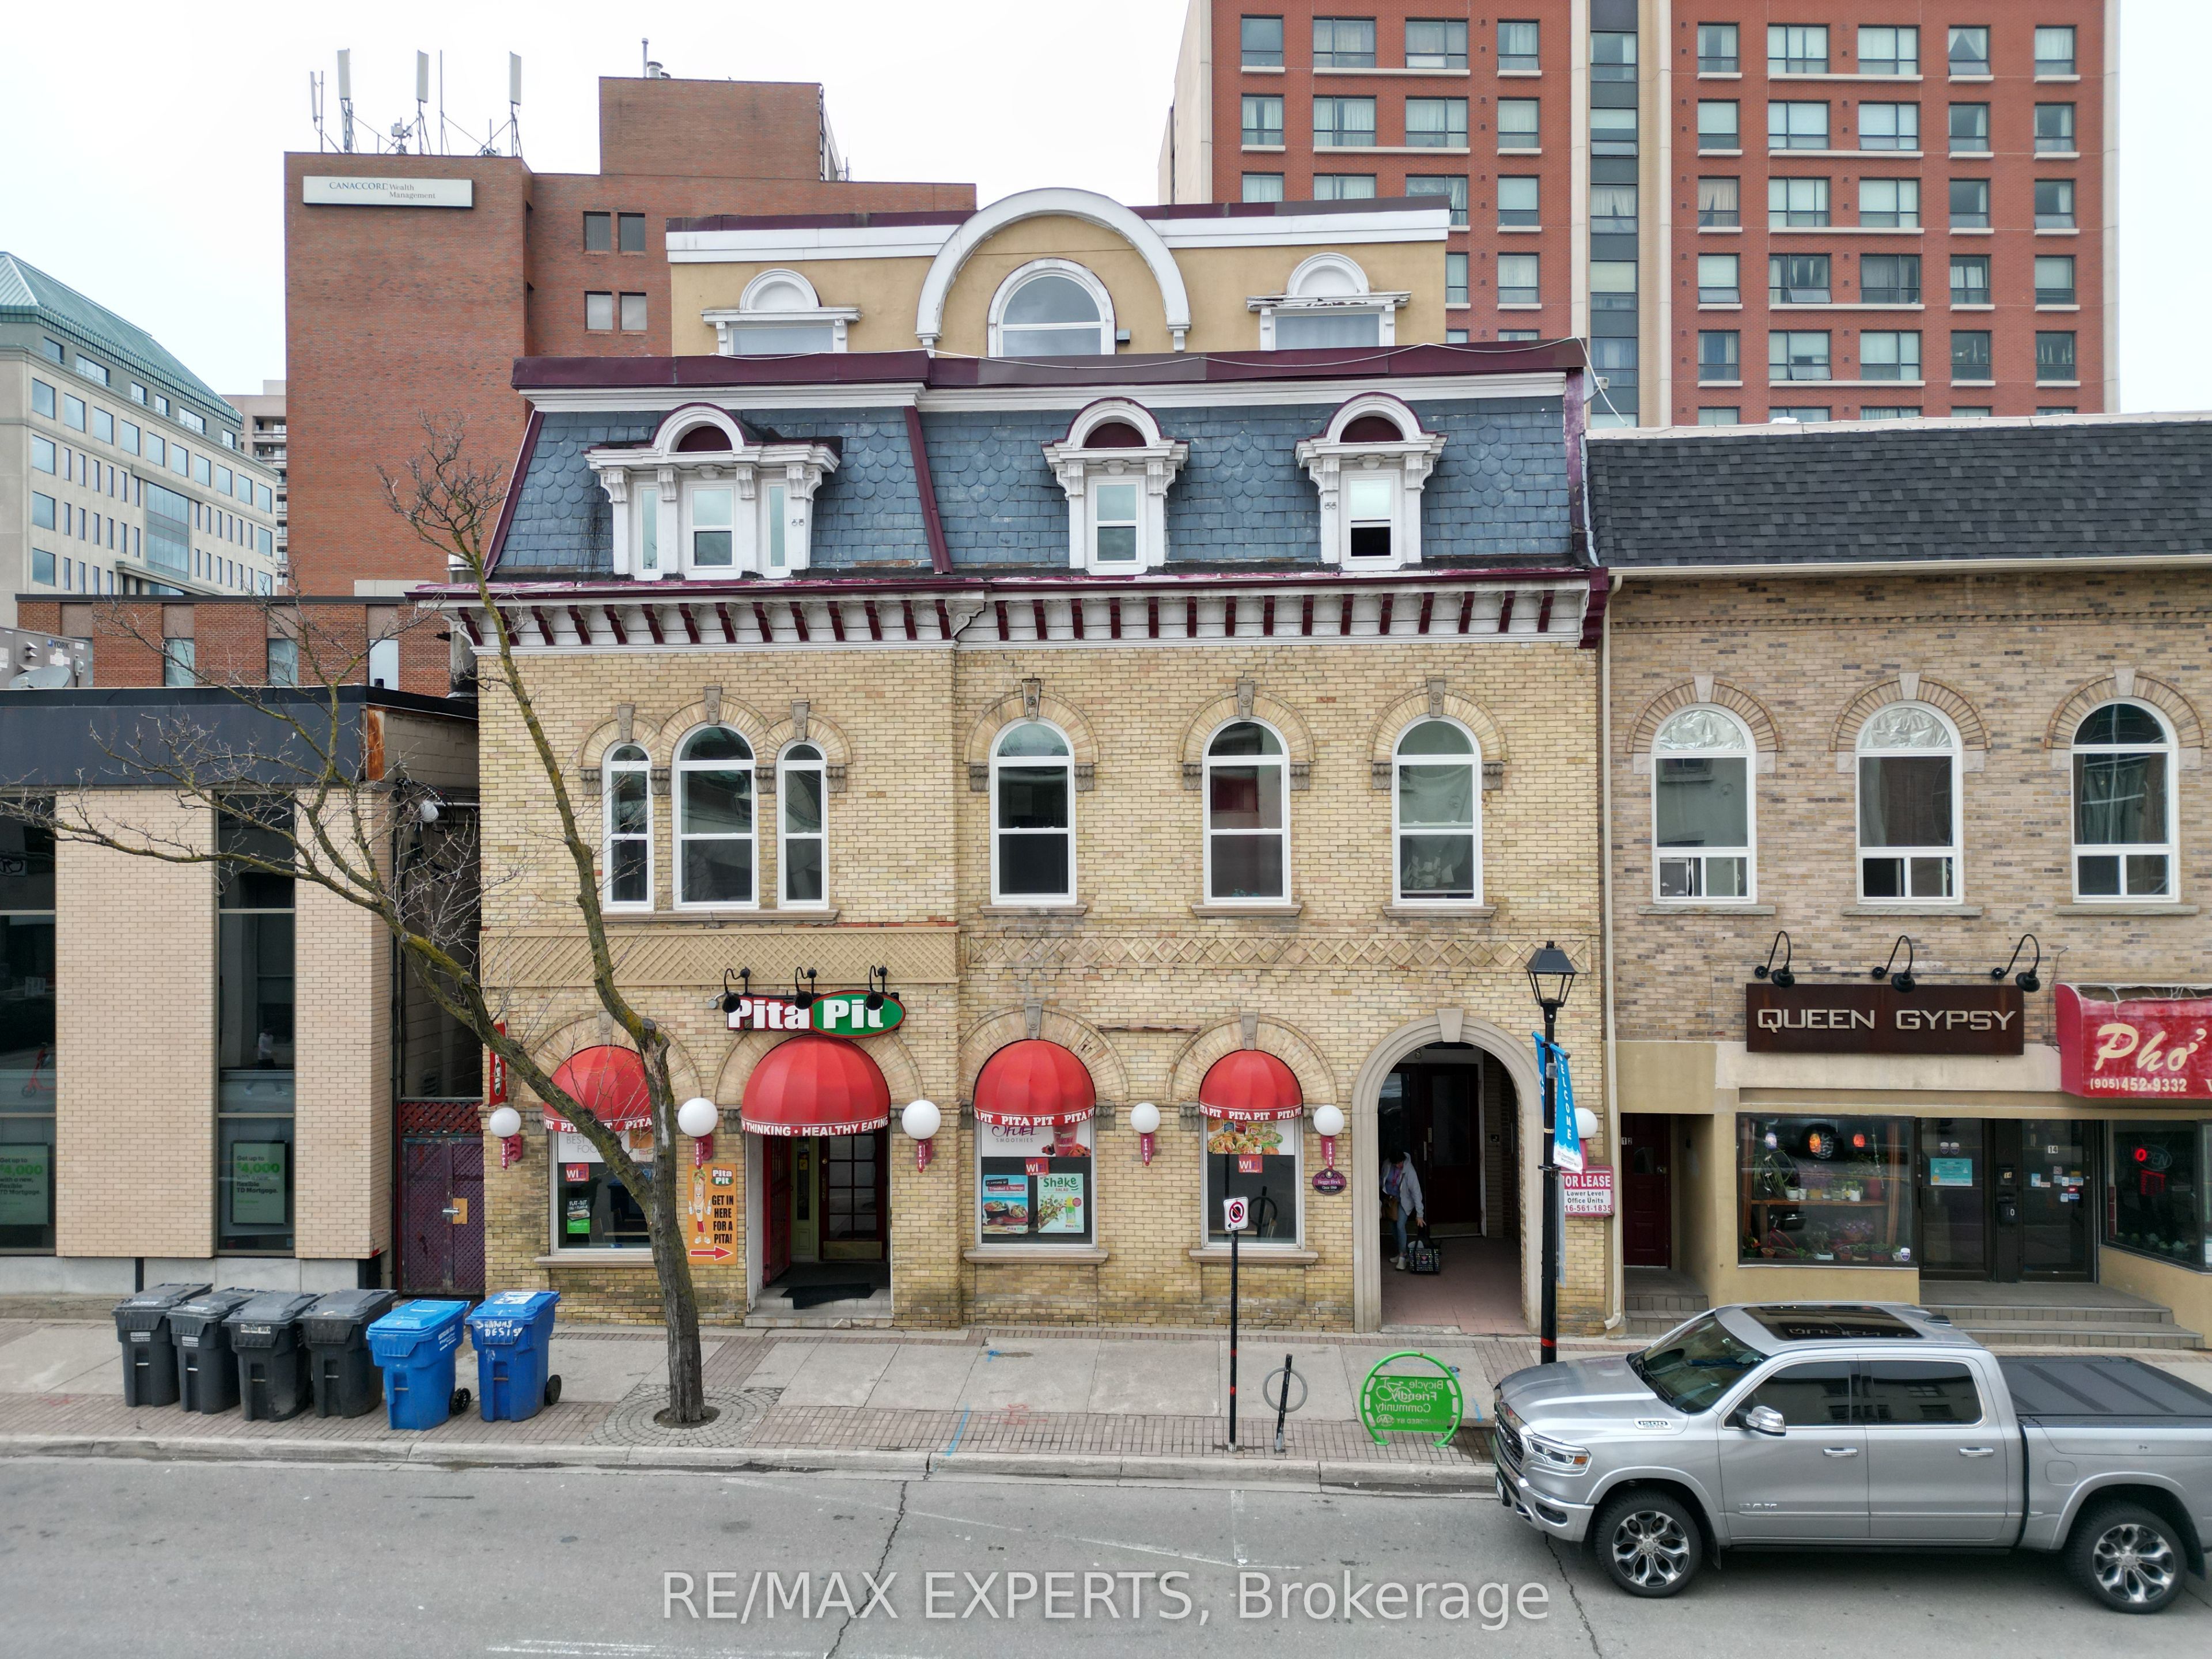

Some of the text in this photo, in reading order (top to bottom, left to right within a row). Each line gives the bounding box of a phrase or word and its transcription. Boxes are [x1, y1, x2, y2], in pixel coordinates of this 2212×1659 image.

[389, 191, 436, 199] Management
[52, 639, 70, 650] YORK
[728, 999, 884, 1029] Pita Pit
[1758, 1009, 2016, 1033] QUEEN GYPSY
[980, 1112, 994, 1123] PIT
[1064, 1112, 1088, 1124] PITA
[1209, 1108, 1222, 1118] PIT
[1229, 1111, 1270, 1120] PITA PIT
[1277, 1110, 1295, 1119] PITA
[625, 1118, 653, 1130] PITA
[1001, 1116, 1055, 1126] PITA PIT
[560, 1122, 578, 1132] PIT
[747, 1123, 791, 1137] THINKING
[802, 1124, 859, 1137] HEALTHY
[861, 1116, 888, 1132] EATING
[566, 1136, 586, 1144] BEST
[577, 1145, 598, 1153] FOO
[236, 1162, 281, 1175] $4,000
[1043, 1177, 1079, 1188] Shake
[1562, 1175, 1611, 1187] OR LEASE
[712, 1195, 734, 1205] GET IN
[714, 1208, 732, 1218] HERE
[713, 1221, 733, 1231] FOR A
[714, 1233, 732, 1244] PITA!
